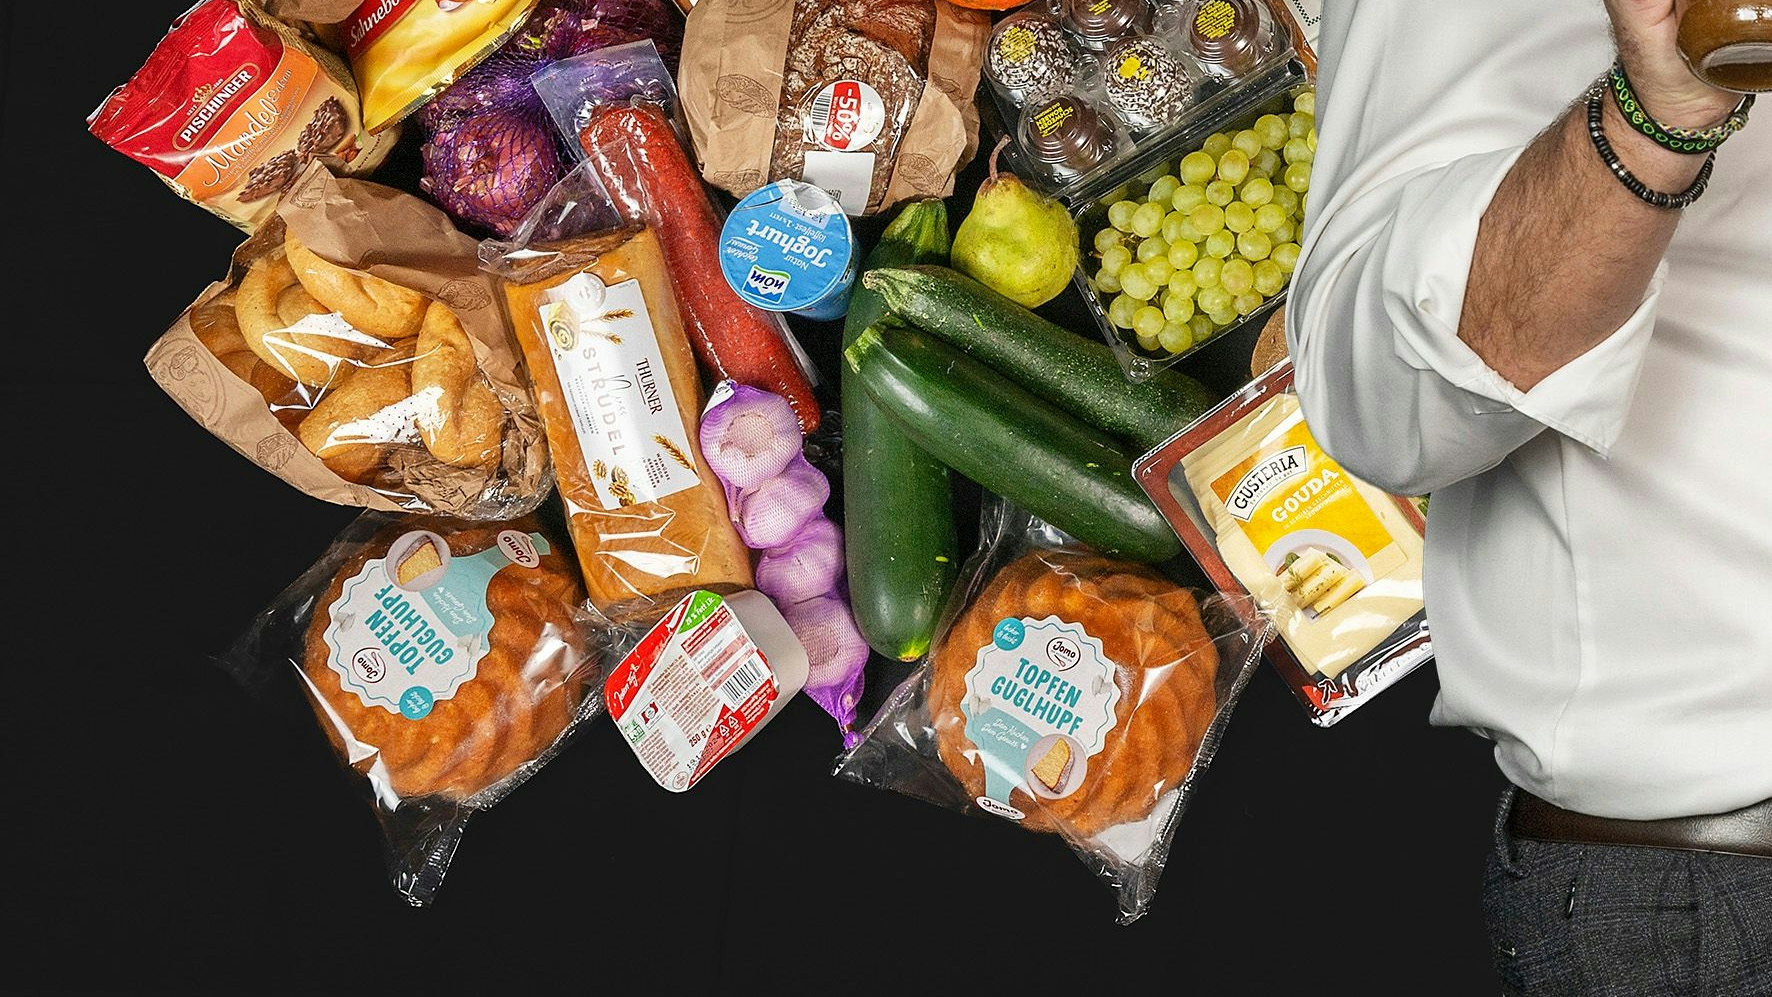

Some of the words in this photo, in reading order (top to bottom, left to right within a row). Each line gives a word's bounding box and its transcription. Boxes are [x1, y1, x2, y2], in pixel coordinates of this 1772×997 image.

[180, 70, 253, 142] PISCHINGER
[187, 104, 198, 116] SEIT
[830, 89, 856, 142] -50%
[203, 97, 282, 187] Mandel
[746, 219, 833, 269] Joghurt
[783, 254, 809, 271] Natur
[750, 270, 785, 291] nöm
[583, 347, 626, 456] STRUDEL
[636, 357, 663, 415] THURNER
[1234, 454, 1298, 510] GUSTERIA
[1271, 468, 1340, 523] GOUDA
[503, 536, 531, 563] Jomo
[365, 608, 425, 675] TOPFEN
[374, 584, 454, 665] GUGLHUPF
[1053, 641, 1076, 658] Jomo
[357, 656, 378, 679] Jomo
[1015, 657, 1082, 708] TOPFEN
[991, 675, 1083, 735] GUGLHUPF
[689, 733, 701, 748] 250
[983, 799, 1018, 815] Jomo
